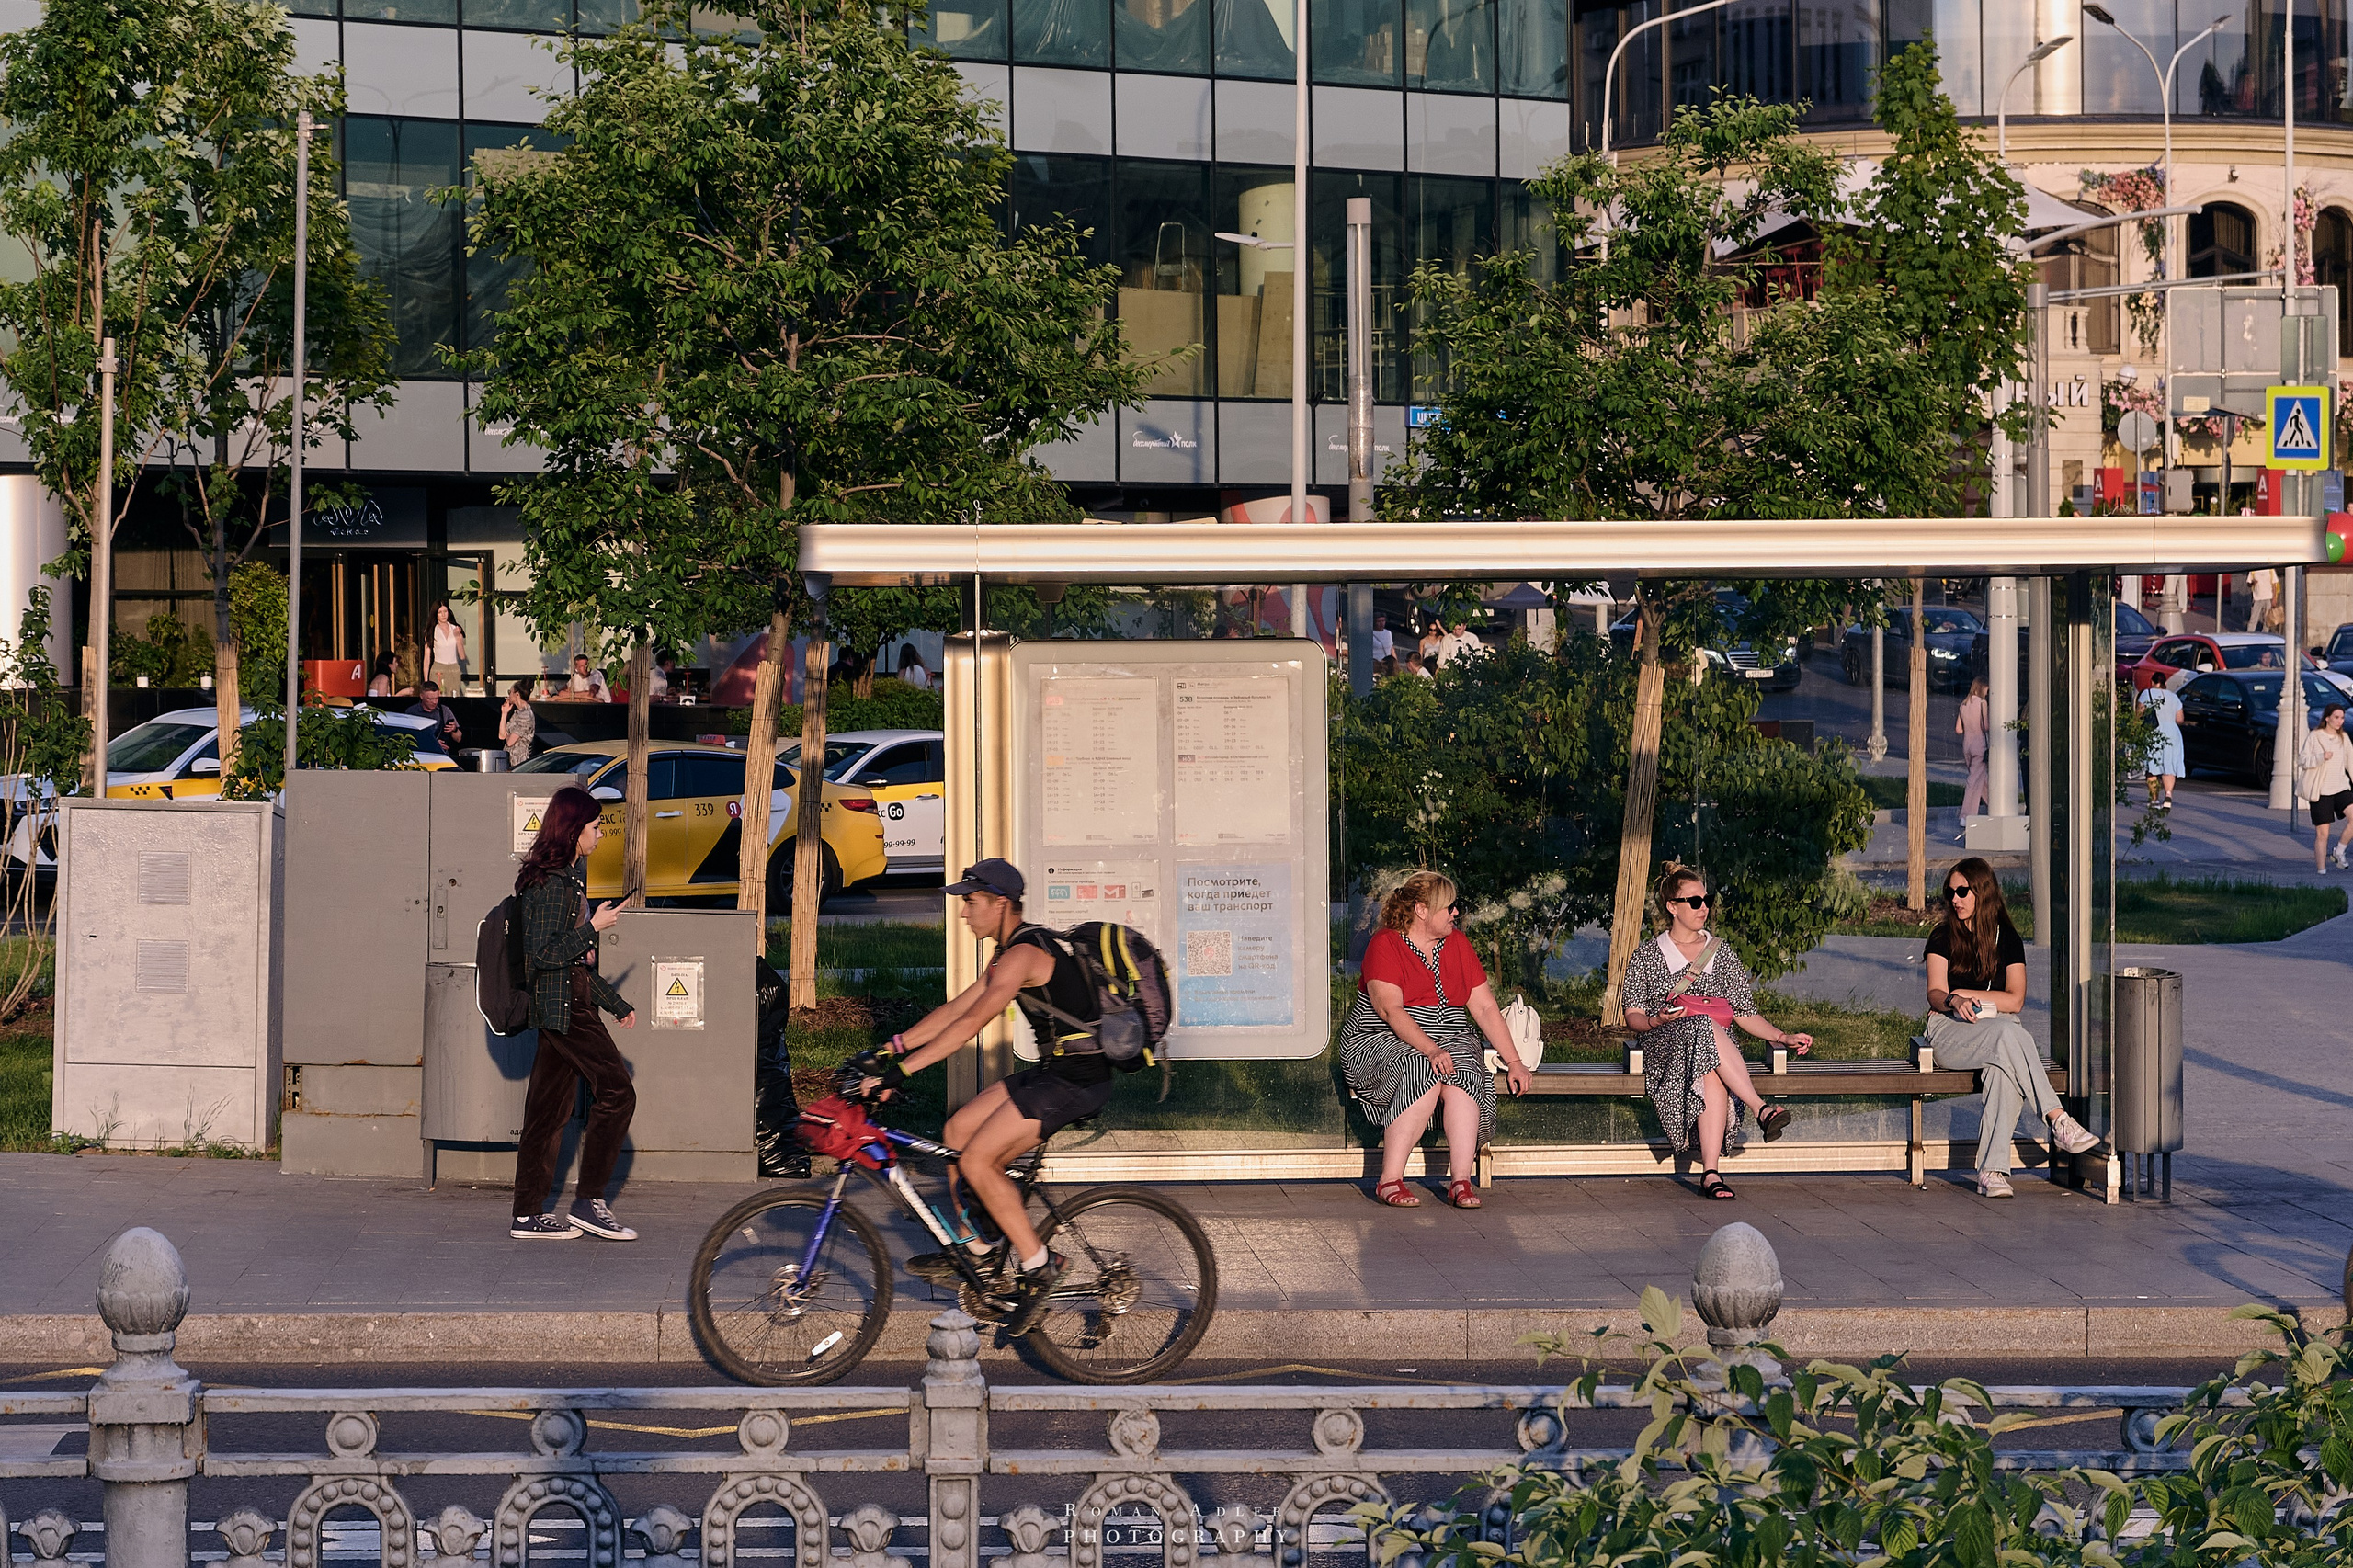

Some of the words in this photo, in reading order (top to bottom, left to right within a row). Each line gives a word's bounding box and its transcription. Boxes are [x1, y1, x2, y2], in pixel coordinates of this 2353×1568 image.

[695, 802, 714, 816] 339
[729, 802, 738, 815] Я
[889, 805, 903, 818] Go
[609, 828, 621, 836] 999
[1188, 877, 1261, 888] Посмотрите,
[1188, 891, 1220, 901] когда
[1222, 890, 1272, 901] приедет
[1188, 903, 1211, 912] ваш
[1213, 902, 1274, 913] транспорт
[1237, 935, 1273, 943] Наведите
